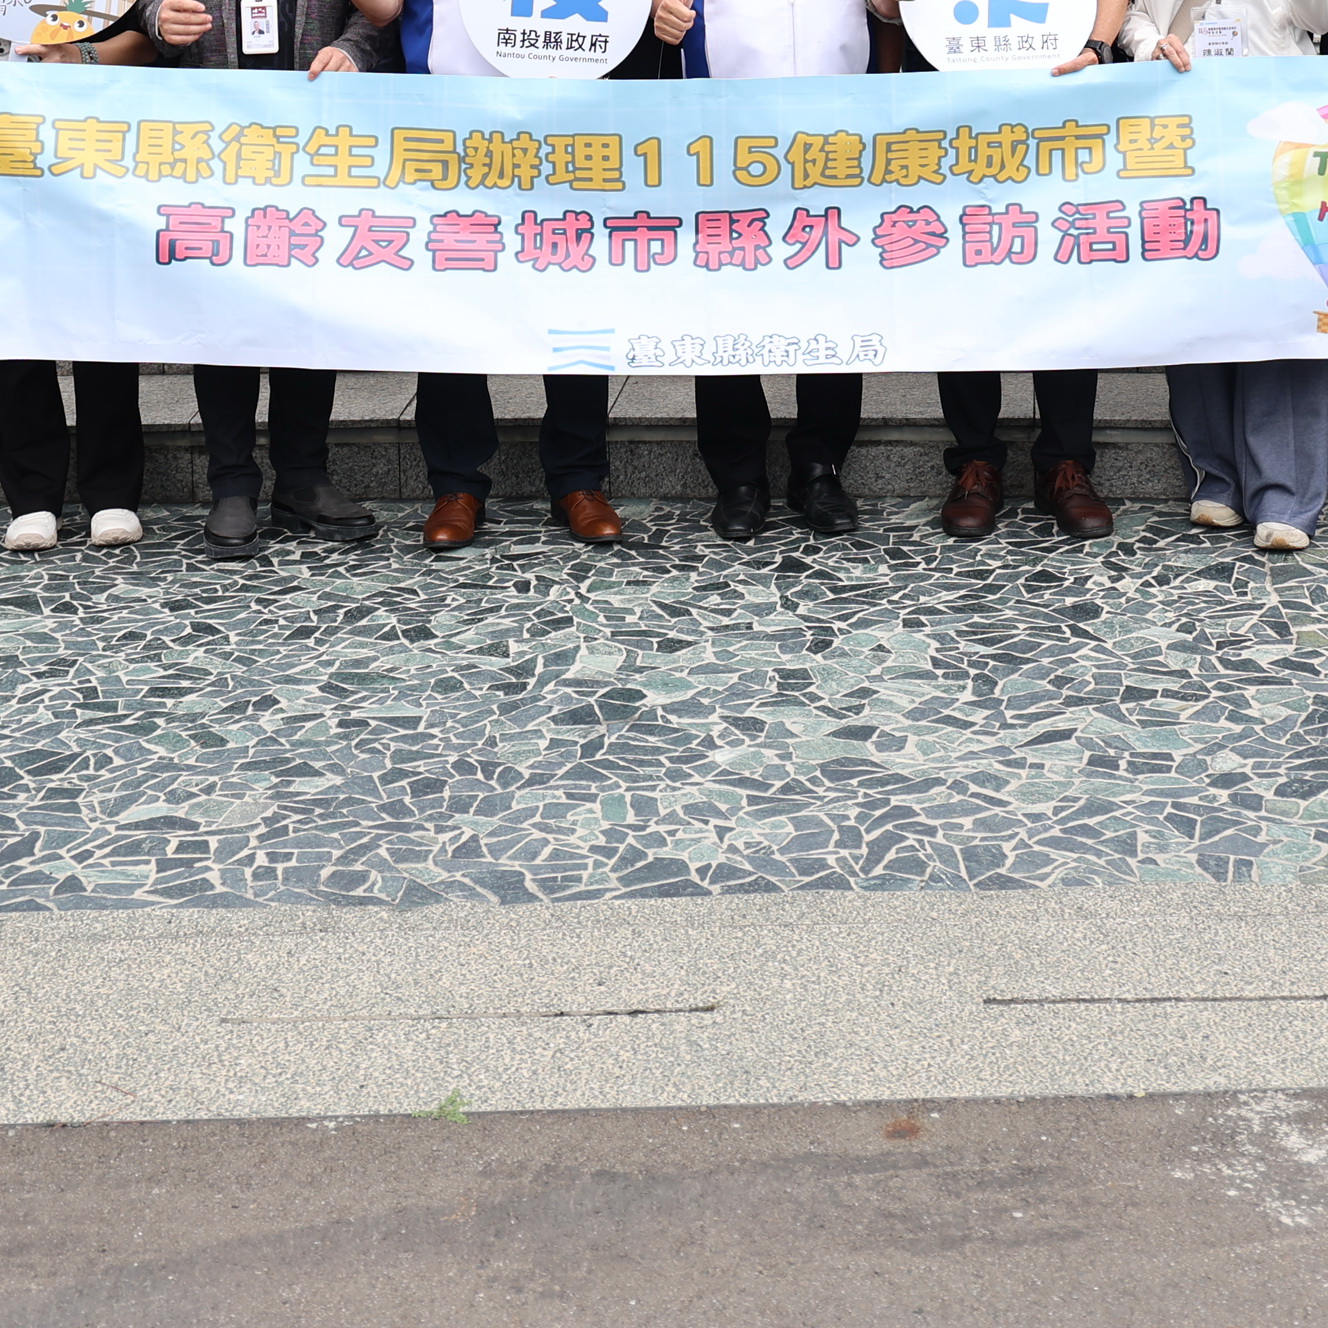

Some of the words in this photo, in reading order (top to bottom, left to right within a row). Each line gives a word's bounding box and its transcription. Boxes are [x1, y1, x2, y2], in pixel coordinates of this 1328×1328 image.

[496, 27, 610, 54] 南投縣政府
[945, 32, 1060, 55] 臺東縣政府
[496, 50, 526, 60] Nantou
[528, 53, 556, 63] County
[558, 55, 608, 65] Government
[980, 54, 1010, 64] County
[1012, 54, 1061, 63] Government
[155, 197, 1221, 273] 高齡友善城市縣外參訪活動
[626, 333, 888, 369] 臺東縣衛生局
